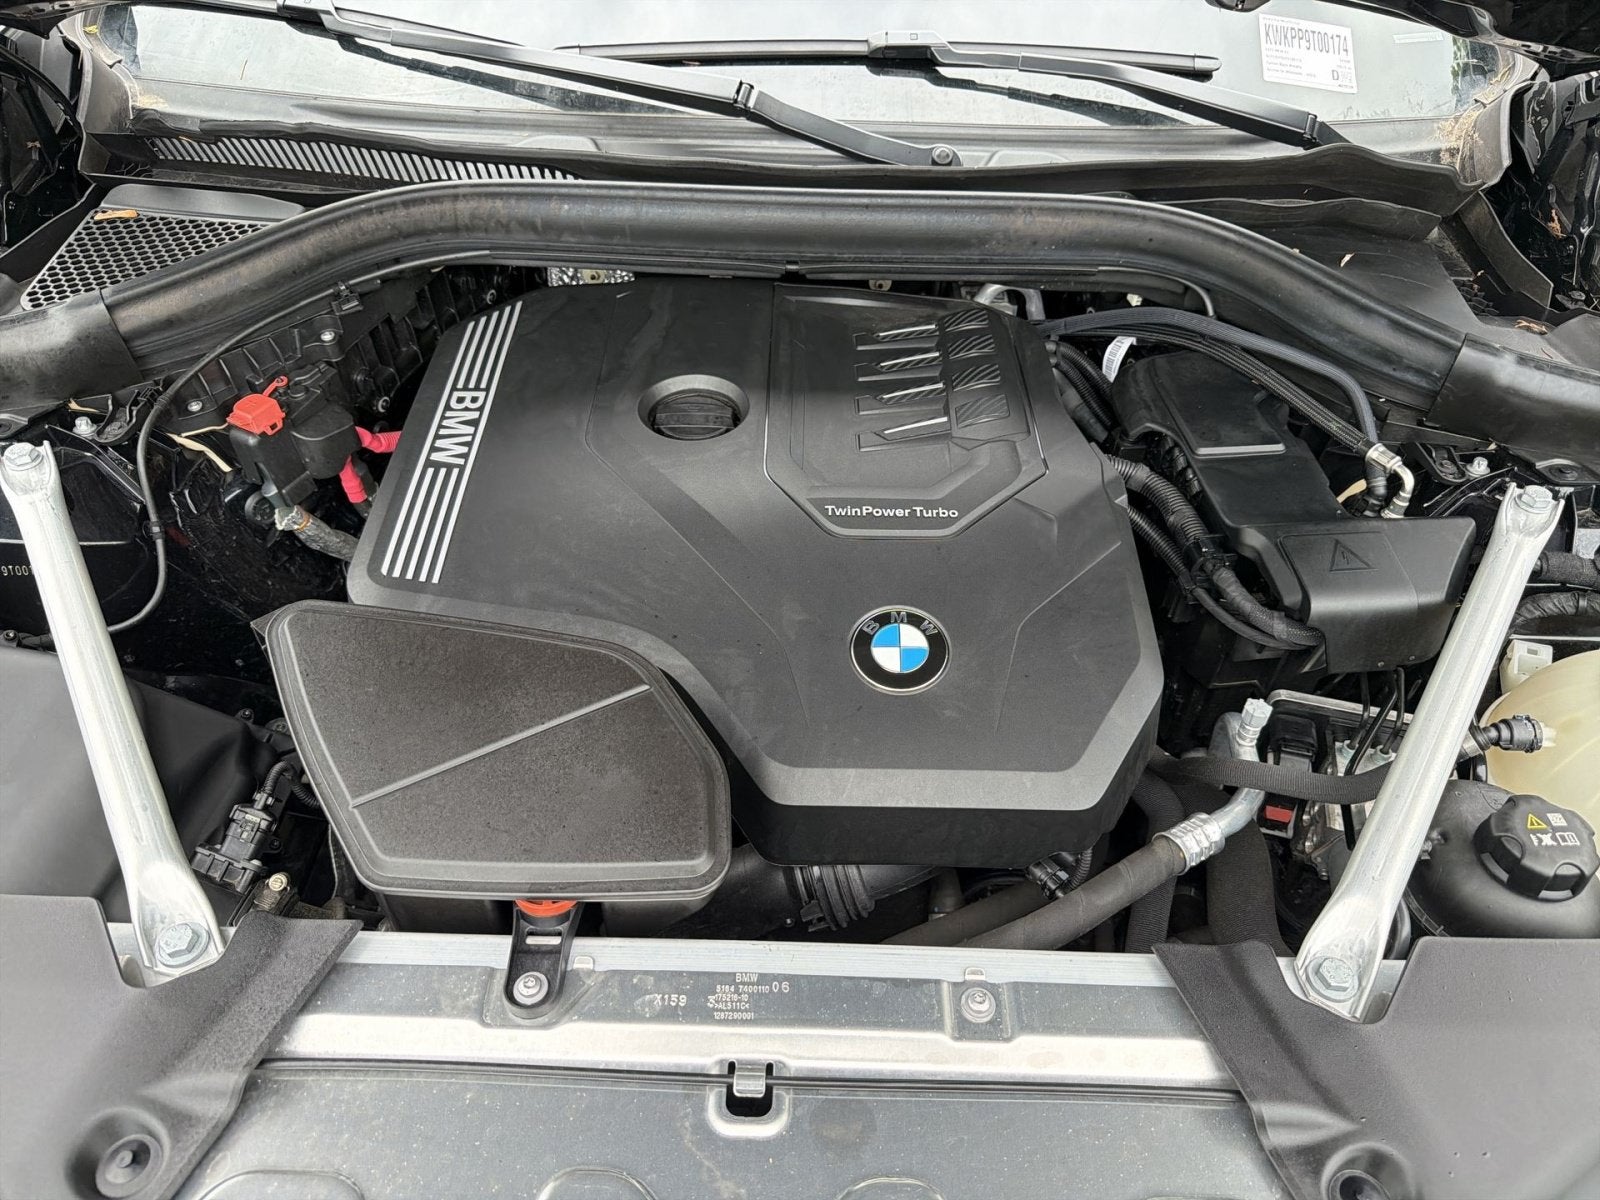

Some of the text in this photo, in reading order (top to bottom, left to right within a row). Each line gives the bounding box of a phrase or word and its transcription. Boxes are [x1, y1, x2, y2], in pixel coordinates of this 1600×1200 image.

[1264, 23, 1349, 56] KWKPP9T00174
[429, 390, 487, 465] BMW
[824, 505, 959, 518] TwinPower Turbo
[861, 611, 939, 636] BMW
[735, 973, 758, 983] BMW
[739, 985, 770, 994] 7400110
